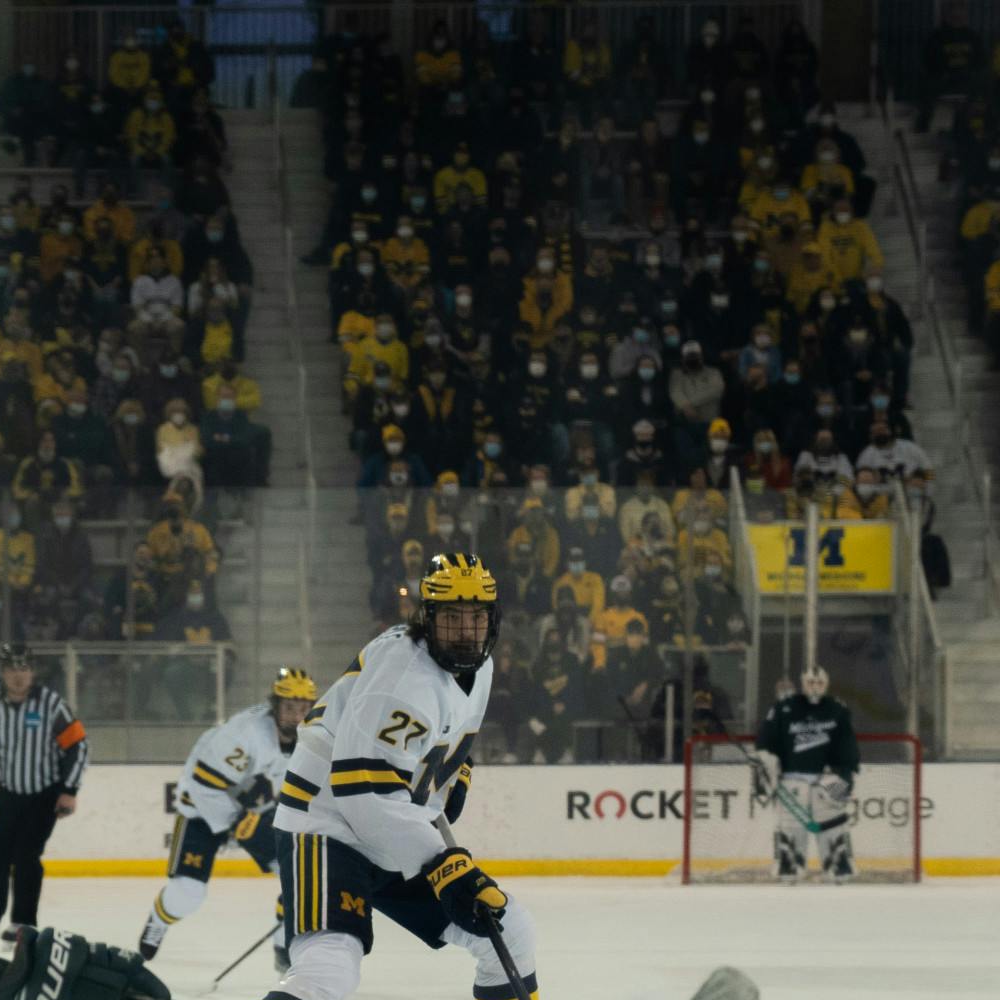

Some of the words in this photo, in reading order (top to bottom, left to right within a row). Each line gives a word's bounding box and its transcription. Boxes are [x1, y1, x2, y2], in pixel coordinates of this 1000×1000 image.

[376, 710, 429, 751] 27
[567, 789, 738, 820] ROCKET
[339, 890, 367, 917] M
